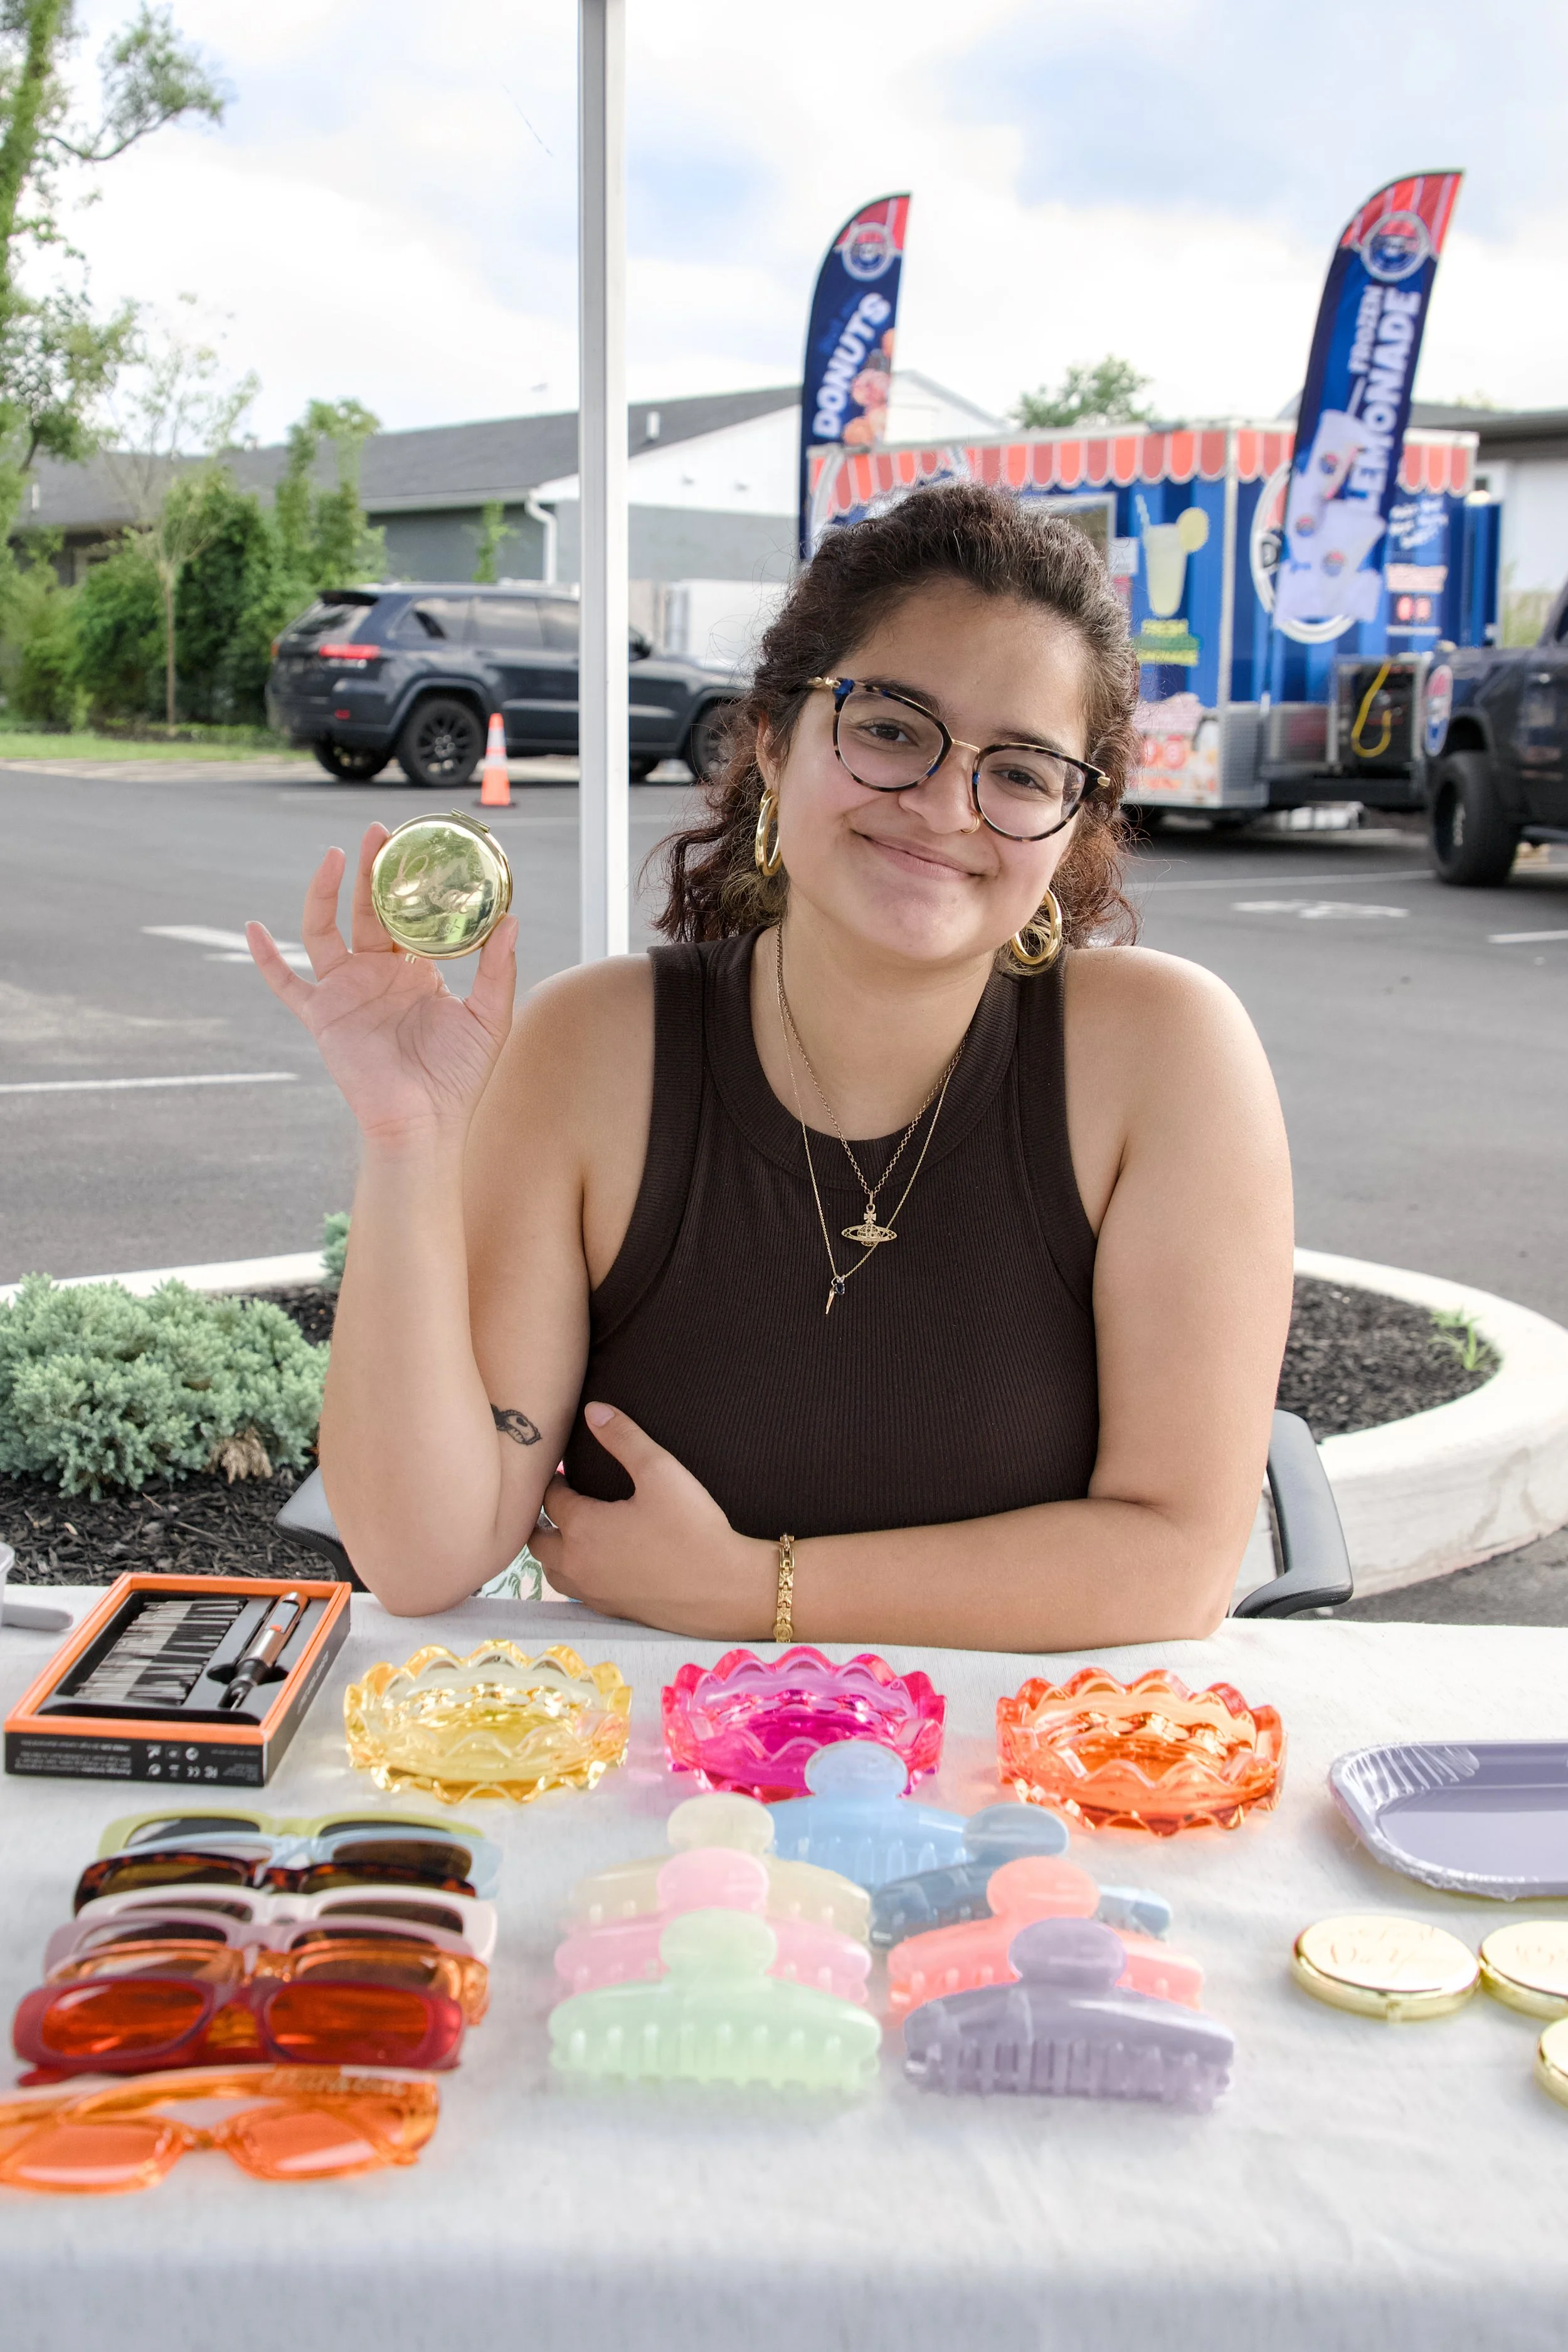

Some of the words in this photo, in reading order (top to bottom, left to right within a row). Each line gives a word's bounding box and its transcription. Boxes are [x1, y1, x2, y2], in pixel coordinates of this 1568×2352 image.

[812, 293, 891, 438] DONUTS
[1347, 287, 1421, 513] LEMONADE
[1348, 285, 1384, 373] FROZEN
